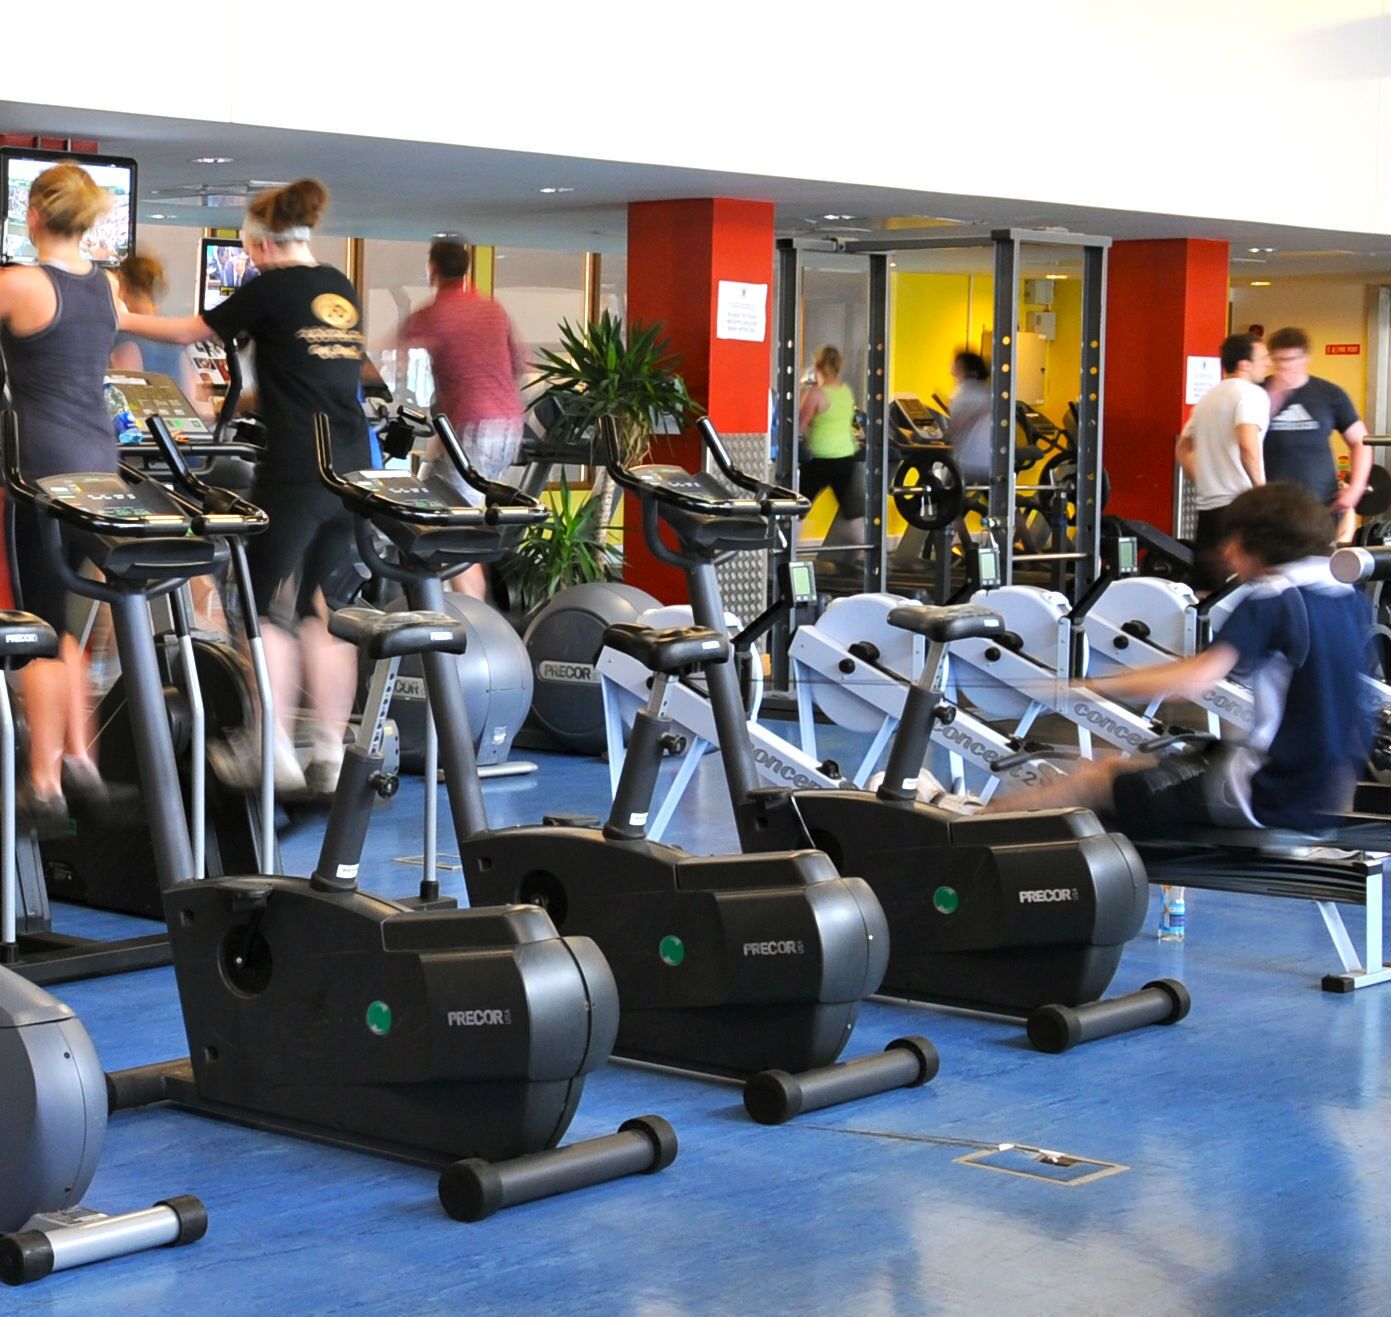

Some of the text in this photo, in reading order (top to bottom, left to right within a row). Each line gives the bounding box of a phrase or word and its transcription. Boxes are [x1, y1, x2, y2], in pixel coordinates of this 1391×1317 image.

[544, 664, 591, 680] PRECOR
[1074, 703, 1148, 746] conce
[1019, 888, 1072, 904] PRECOR
[743, 941, 797, 956] PRECOR
[448, 1009, 504, 1026] PRECOR
